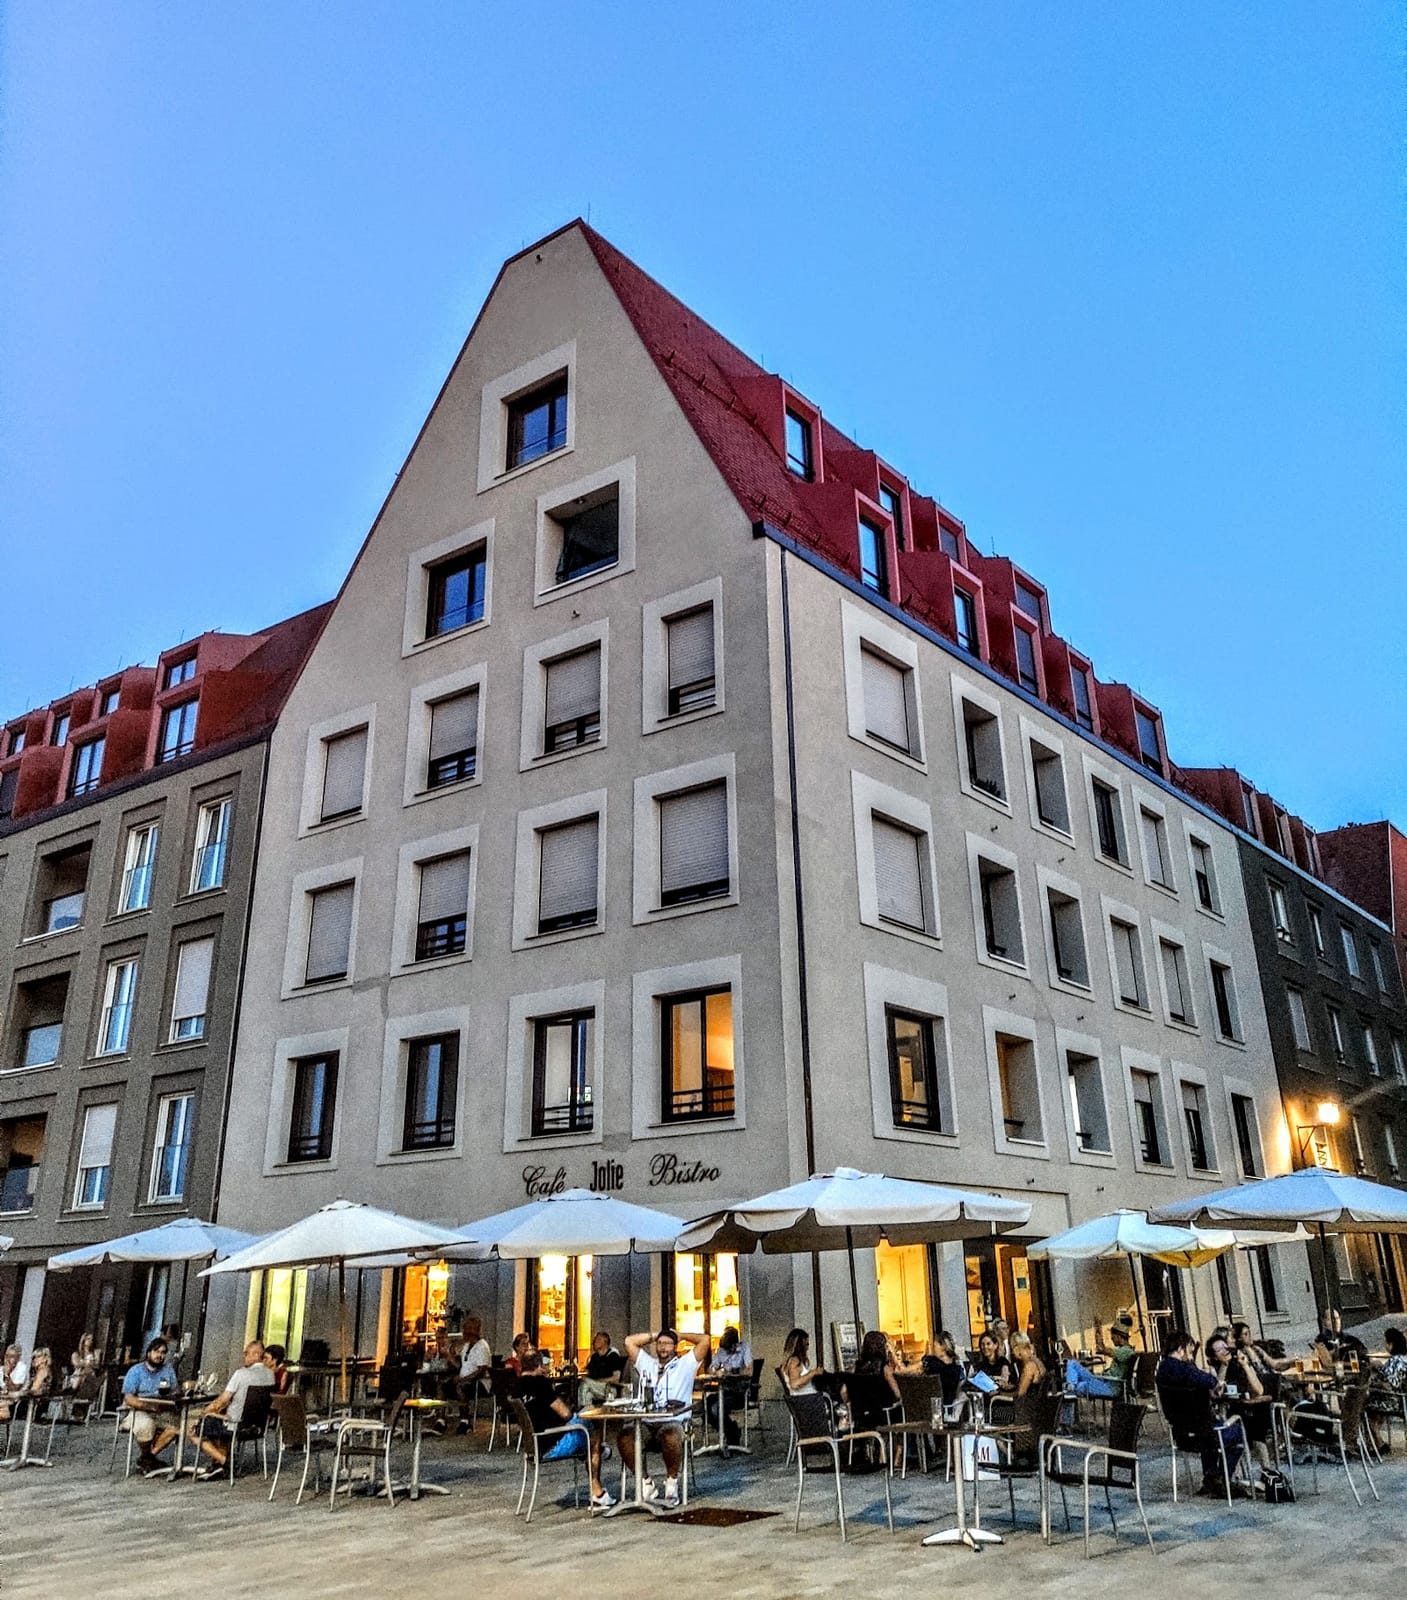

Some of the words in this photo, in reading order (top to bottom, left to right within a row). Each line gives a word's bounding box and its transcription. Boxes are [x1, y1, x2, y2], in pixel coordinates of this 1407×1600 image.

[522, 1165, 567, 1197] Café
[589, 1159, 624, 1192] Jolie
[649, 1153, 721, 1186] Bistro
